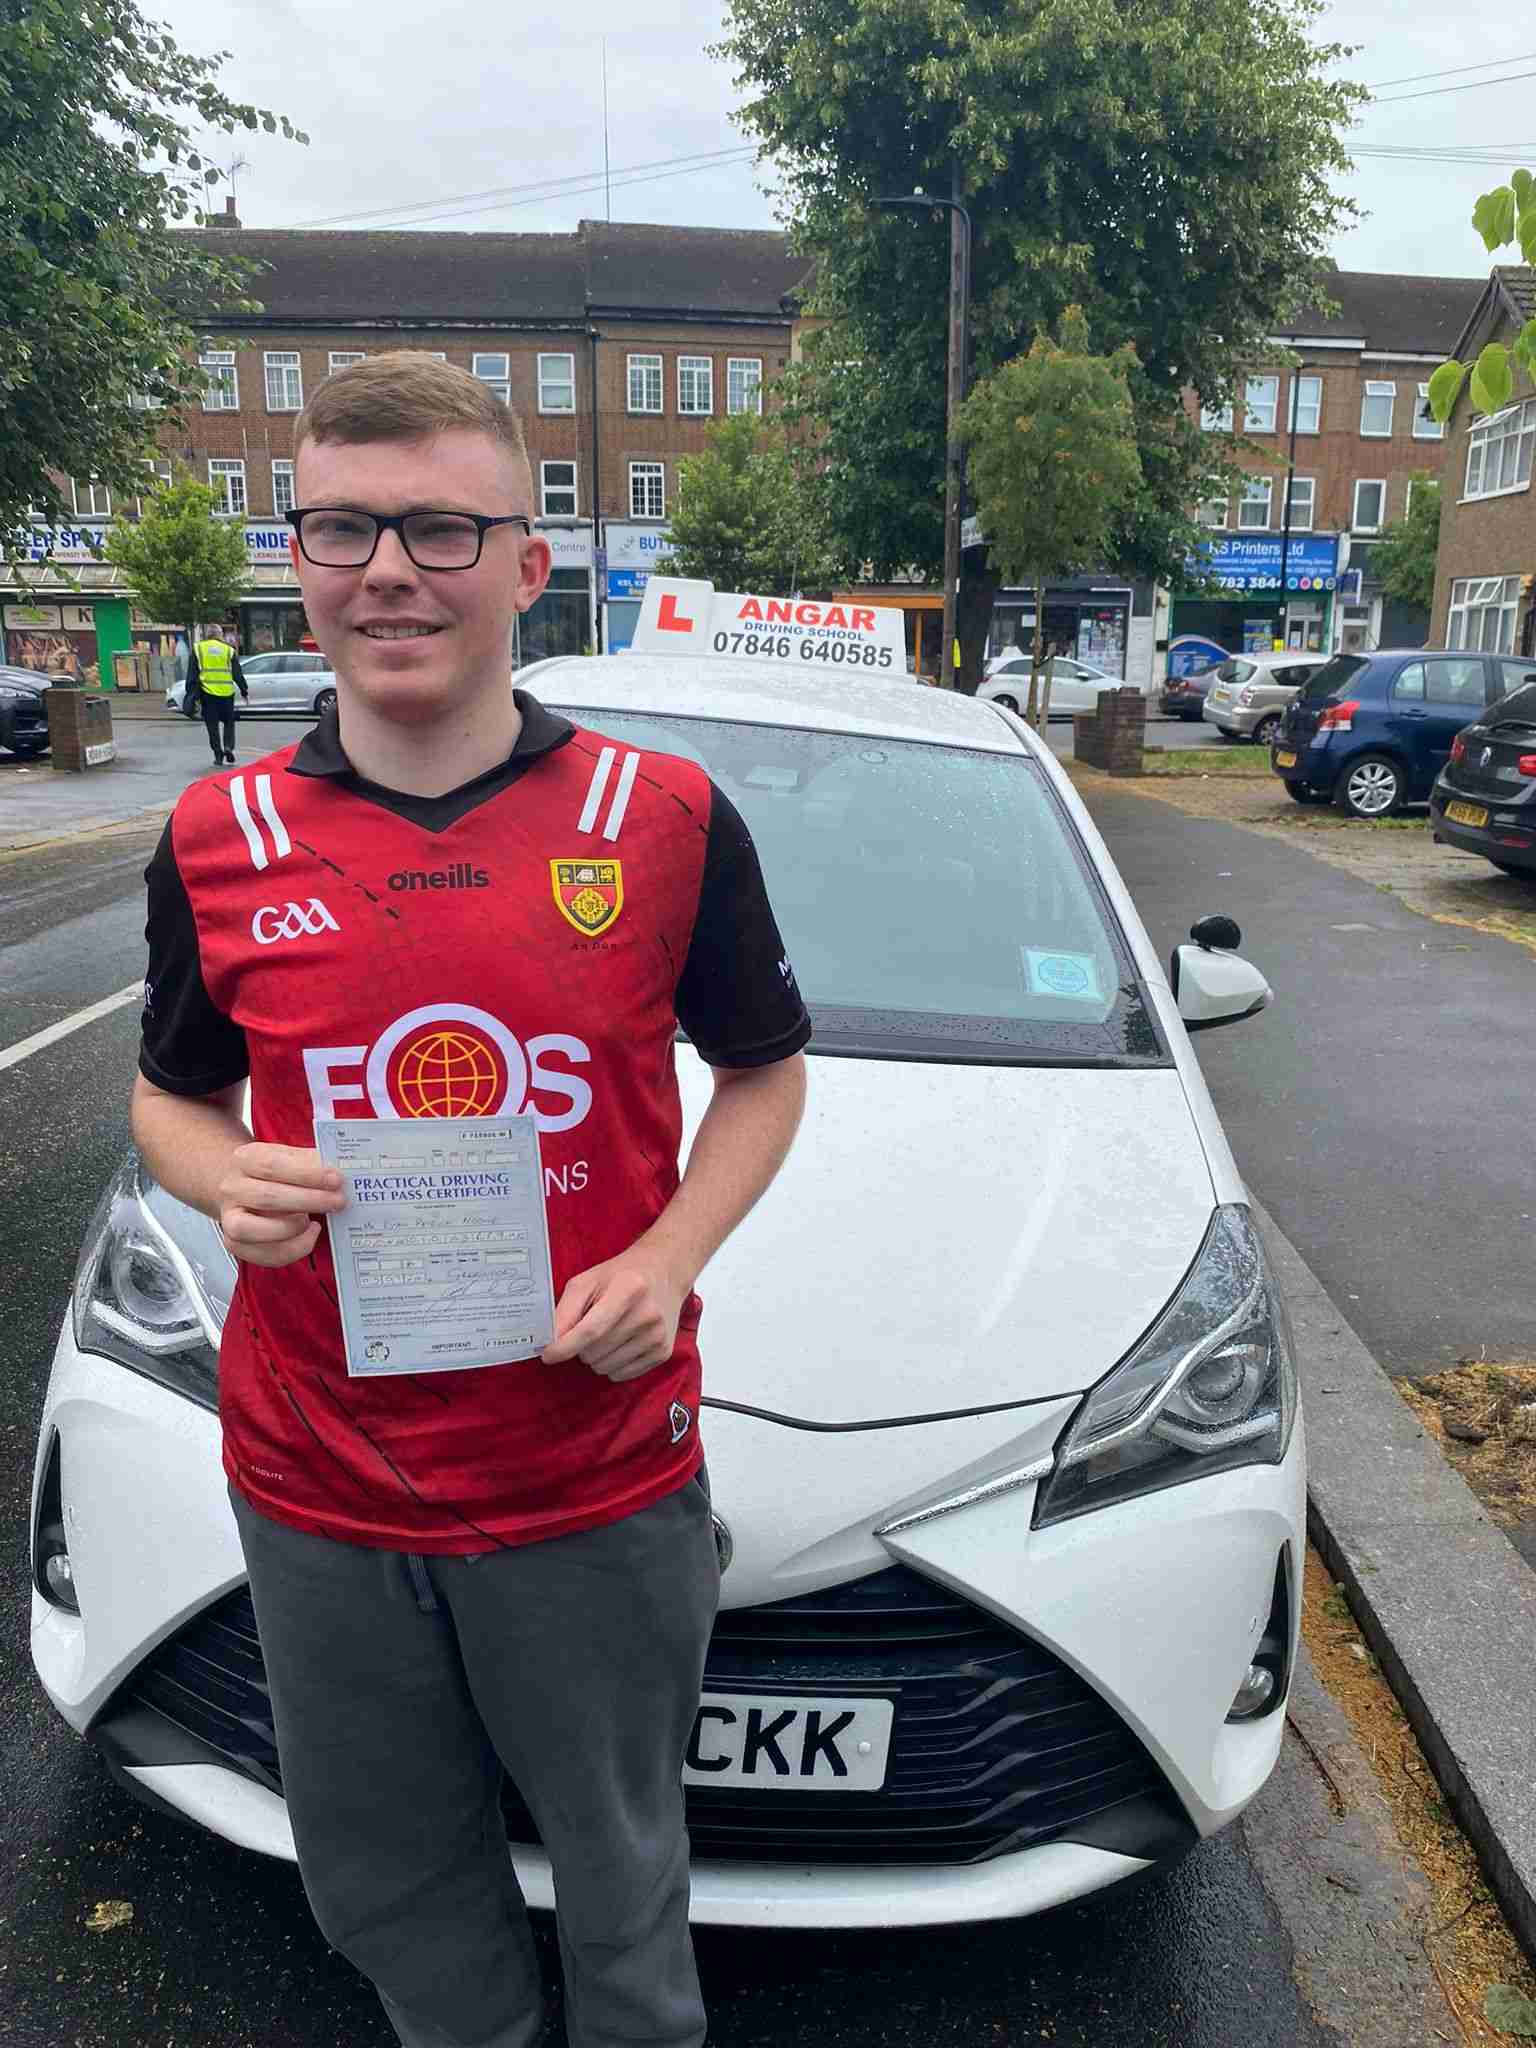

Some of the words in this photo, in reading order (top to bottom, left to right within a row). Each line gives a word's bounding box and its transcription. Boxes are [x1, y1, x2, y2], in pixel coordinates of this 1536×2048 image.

[1231, 541, 1281, 556] Printers
[657, 594, 694, 633] L
[738, 598, 876, 631] ANGAR
[744, 621, 803, 636] DRIVING
[807, 627, 865, 642] SCHOOL
[713, 631, 791, 658] 07846
[799, 639, 893, 668] 640585
[251, 897, 341, 944] GAA
[302, 1002, 593, 1133] EOS
[353, 1176, 437, 1191] PRACTICAL
[441, 1171, 510, 1188] DRIVING
[355, 1191, 386, 1203] TEST
[390, 1189, 424, 1201] PASS
[426, 1184, 512, 1200] CERTIFICATE
[685, 1705, 856, 1777] CKK
